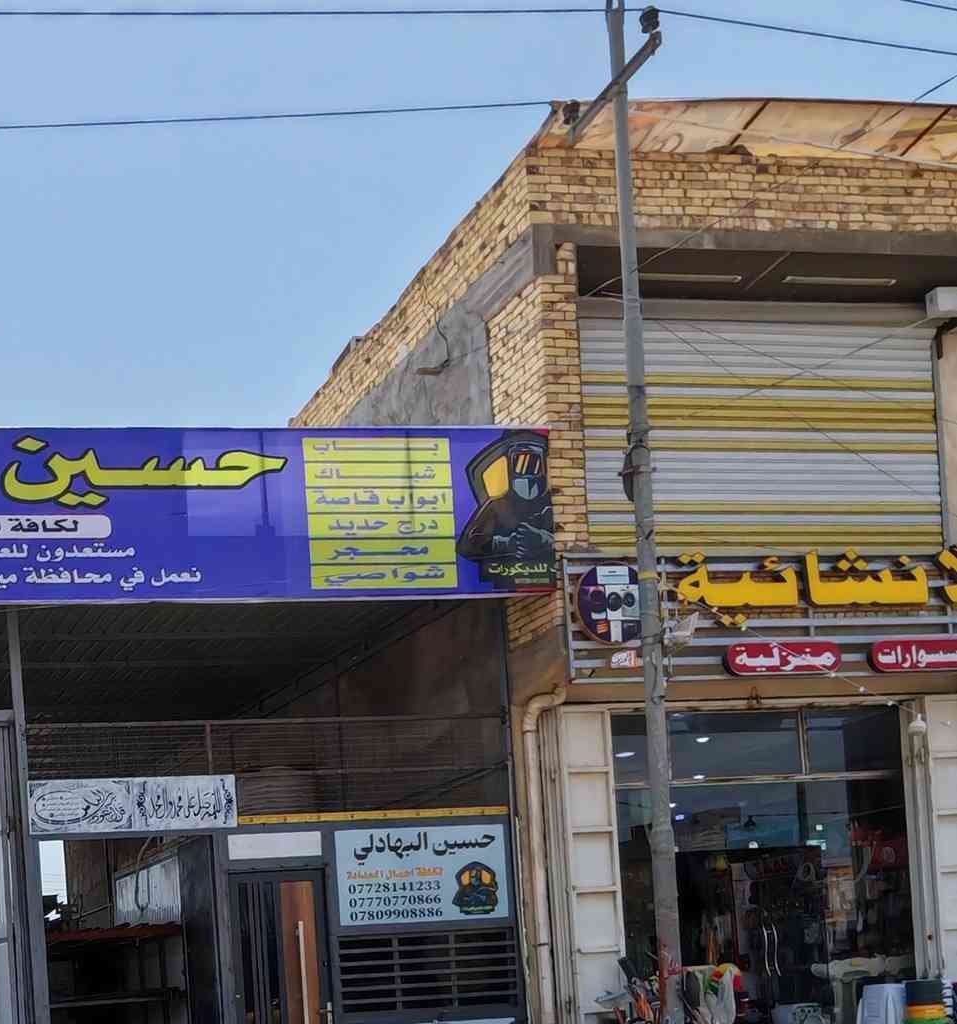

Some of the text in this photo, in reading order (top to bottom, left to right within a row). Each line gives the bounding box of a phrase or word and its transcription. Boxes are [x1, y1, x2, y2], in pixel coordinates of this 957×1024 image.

[1, 435, 288, 508] حسين
[387, 492, 446, 510] ابواب
[11, 518, 79, 534] لكافة
[328, 519, 439, 536] درج حديد
[36, 542, 136, 562] مستعدون
[23, 566, 113, 585] محافظة
[120, 567, 145, 592] في
[151, 567, 202, 587] نعمل
[734, 643, 837, 673] منزلية
[353, 831, 496, 866] حسين البهادلي
[348, 880, 442, 895] 07728141233
[349, 894, 442, 909] 07770770866
[350, 907, 443, 922] 07809908886
